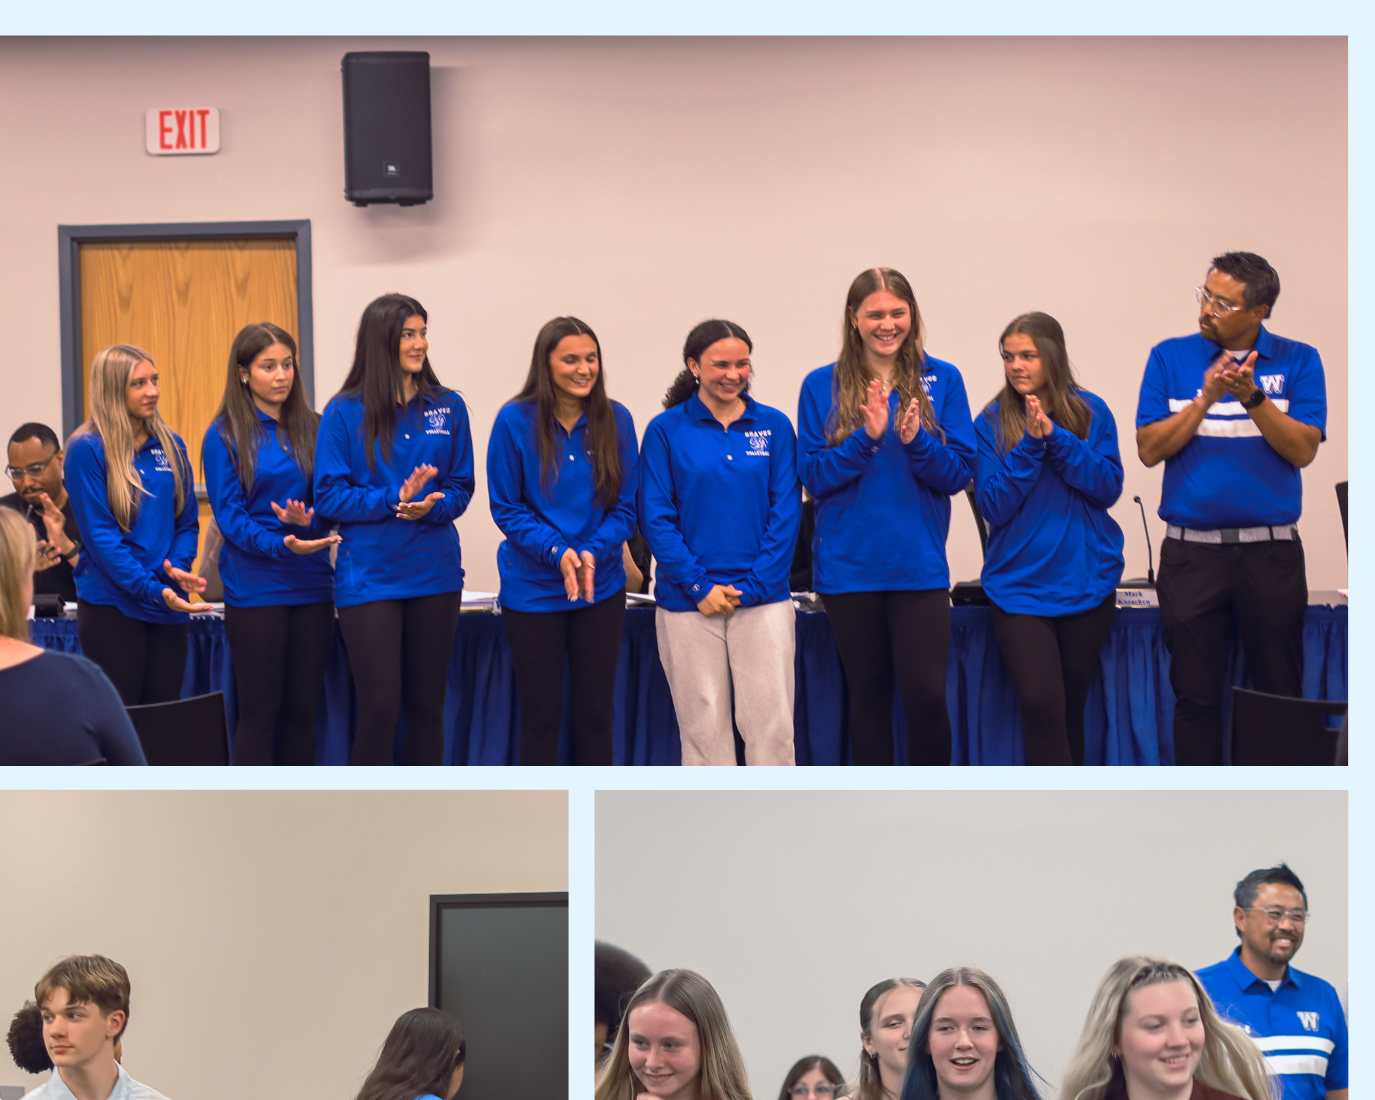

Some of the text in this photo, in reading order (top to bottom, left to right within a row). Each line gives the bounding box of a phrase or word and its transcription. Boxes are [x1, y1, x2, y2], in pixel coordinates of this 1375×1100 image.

[159, 109, 210, 150] EXIT
[1259, 374, 1285, 395] W
[1296, 1011, 1320, 1032] W
